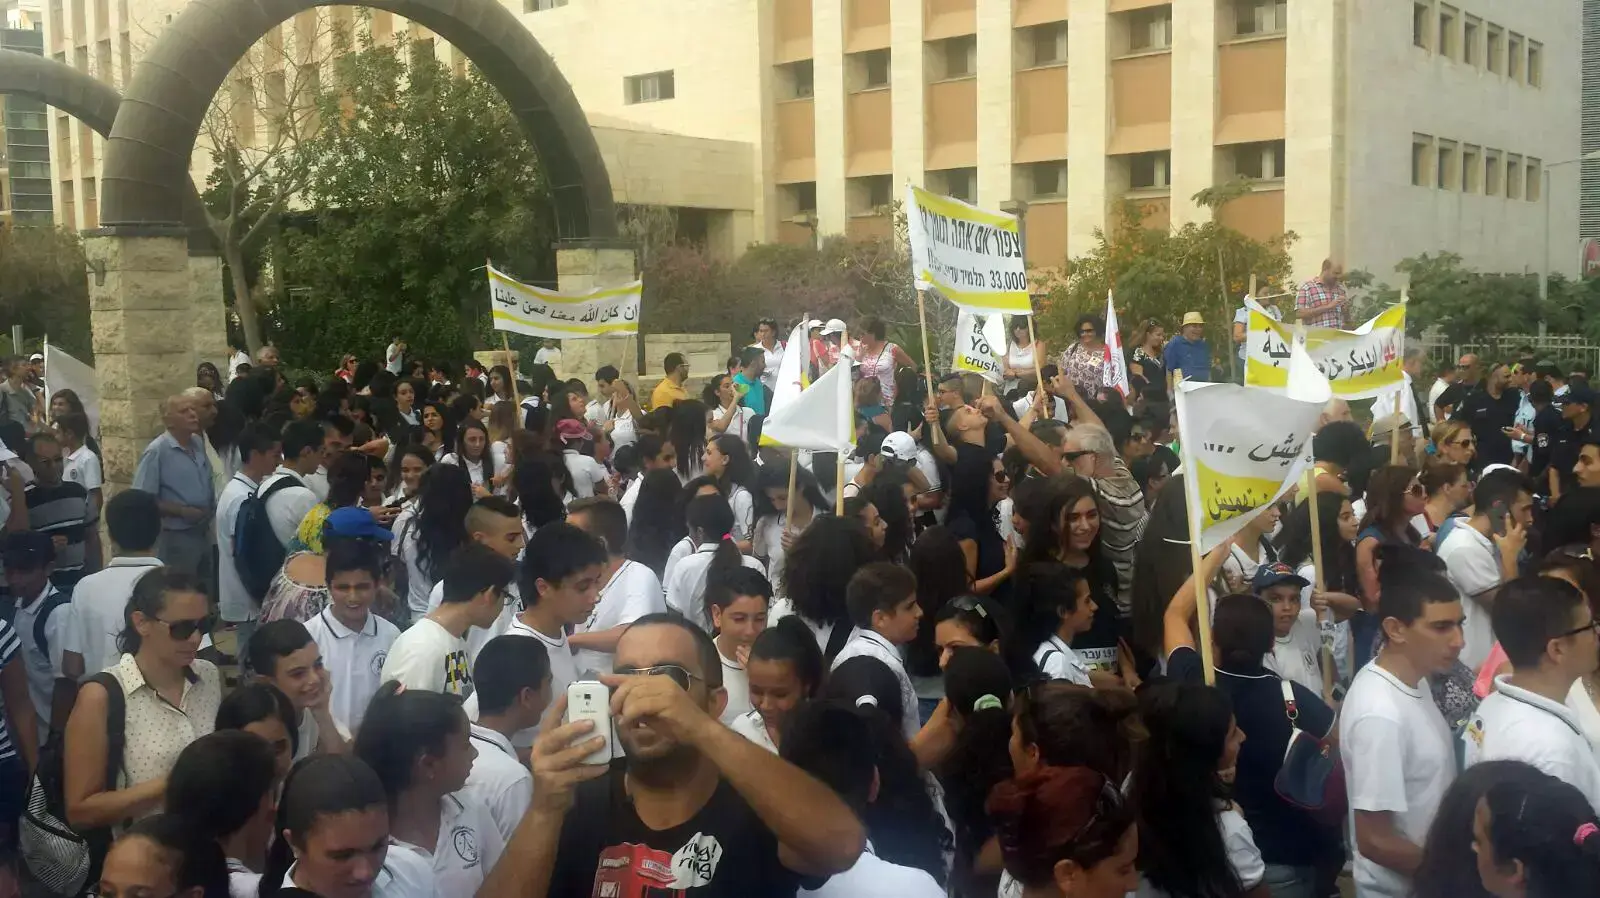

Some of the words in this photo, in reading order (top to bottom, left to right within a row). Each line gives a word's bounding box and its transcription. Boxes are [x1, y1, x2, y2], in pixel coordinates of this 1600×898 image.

[951, 218, 974, 252] אתה
[975, 225, 992, 255] אם
[993, 230, 1022, 258] צפור
[960, 267, 985, 288] תלמיד
[989, 270, 1026, 293] 33,000
[495, 288, 517, 307] علينا
[550, 310, 575, 321] معنا
[580, 304, 599, 322] الله
[600, 304, 619, 323] كان
[624, 304, 637, 320] ان
[971, 336, 994, 357] Yo
[679, 856, 711, 881] ring
